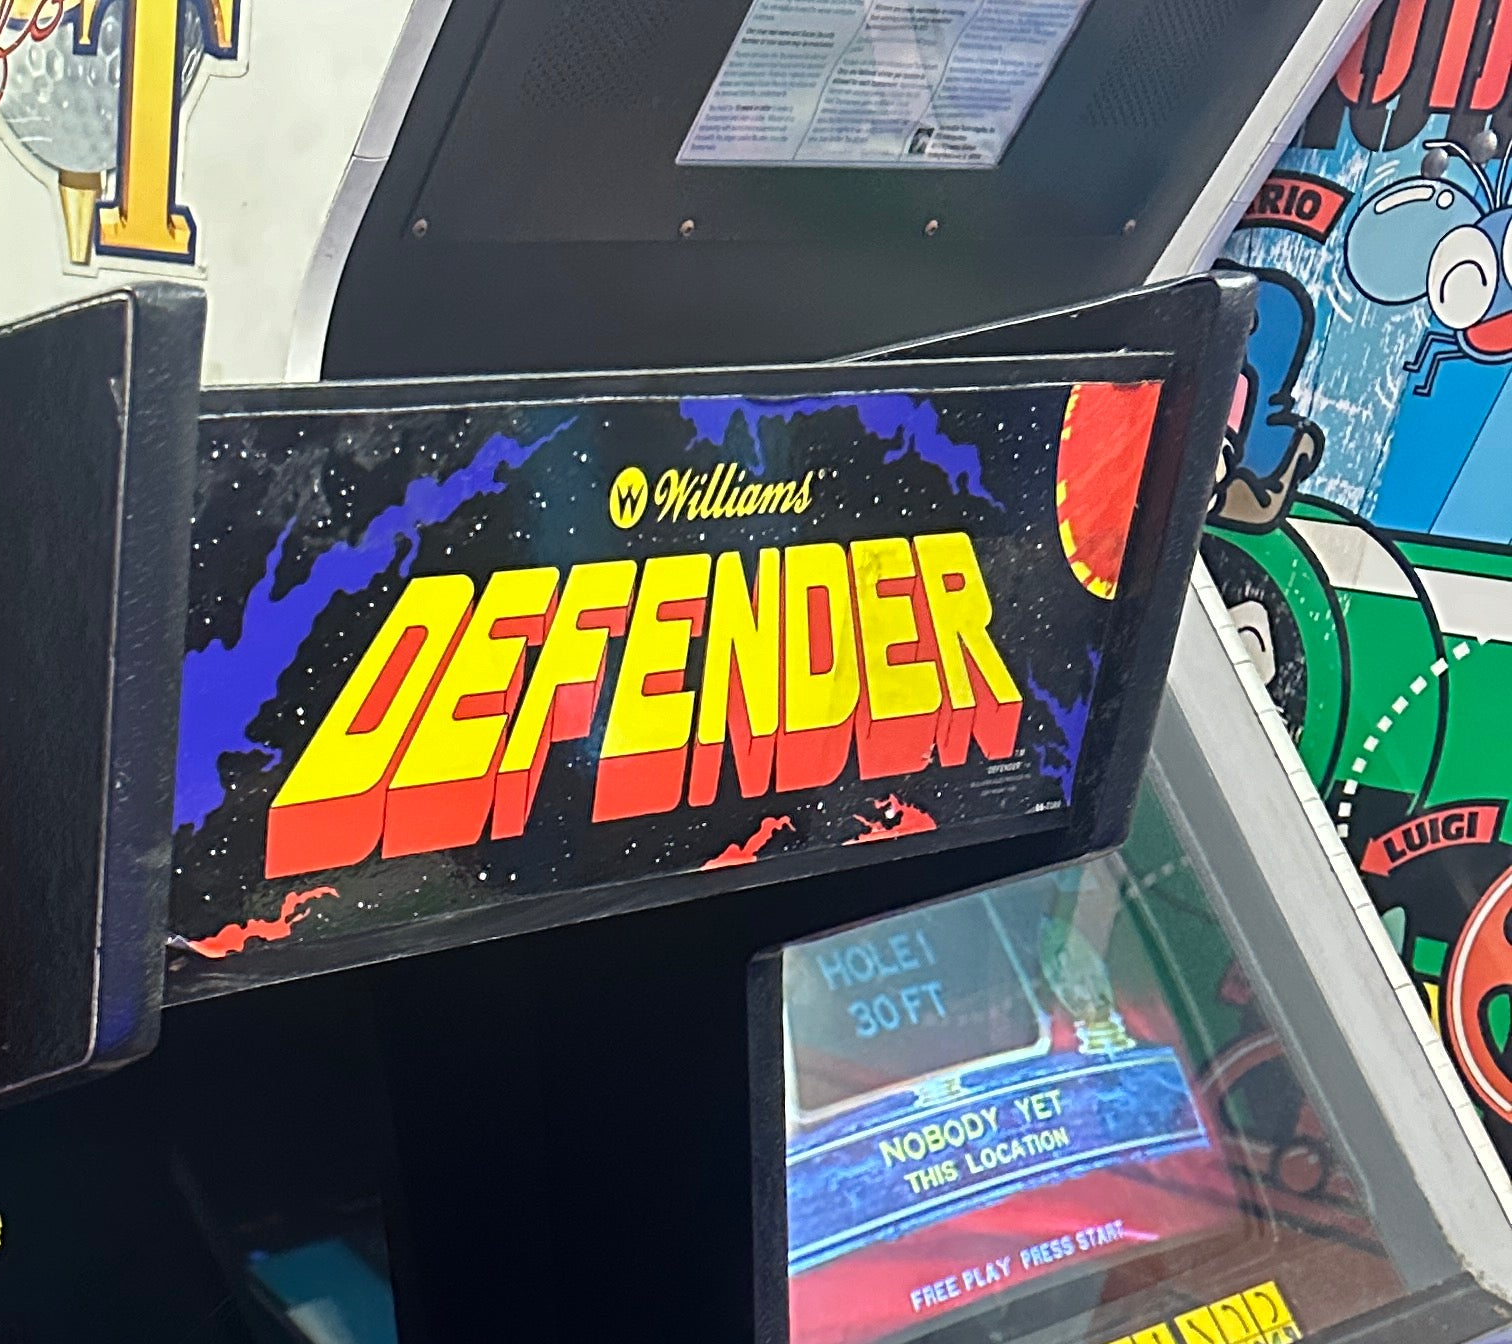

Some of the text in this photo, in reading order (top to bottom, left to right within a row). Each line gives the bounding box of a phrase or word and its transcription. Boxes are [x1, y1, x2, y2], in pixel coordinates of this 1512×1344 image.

[1246, 184, 1322, 221] RIO
[654, 462, 815, 524] Williams
[264, 531, 1025, 879] DEFENDER
[1383, 809, 1479, 864] LUIGI
[816, 933, 921, 991] HOLE
[848, 980, 946, 1038] 30 FT
[879, 1090, 1062, 1167] NOBODY YET
[904, 1127, 1069, 1193] THIS LOCATION
[910, 1219, 1124, 1312] FREE PLAY PRESS START
